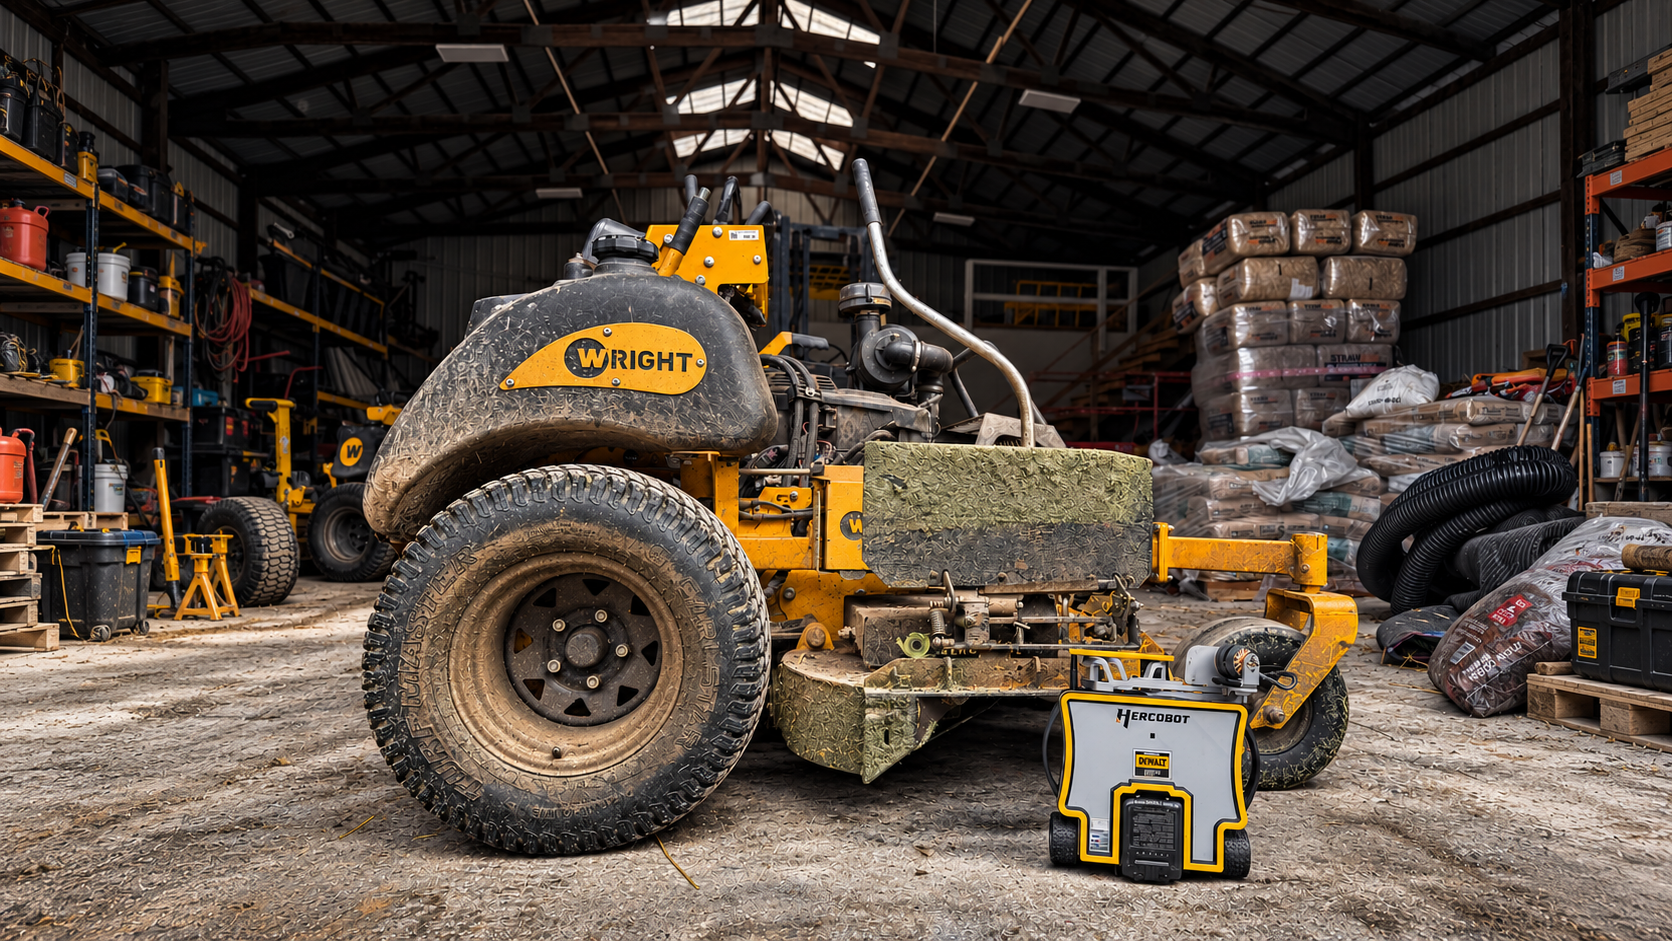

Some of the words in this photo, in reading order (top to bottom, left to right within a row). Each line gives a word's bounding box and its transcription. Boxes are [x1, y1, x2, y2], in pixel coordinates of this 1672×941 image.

[577, 348, 693, 372] WRIGHT
[347, 445, 362, 459] W
[1116, 708, 1190, 729] HERCOBOT
